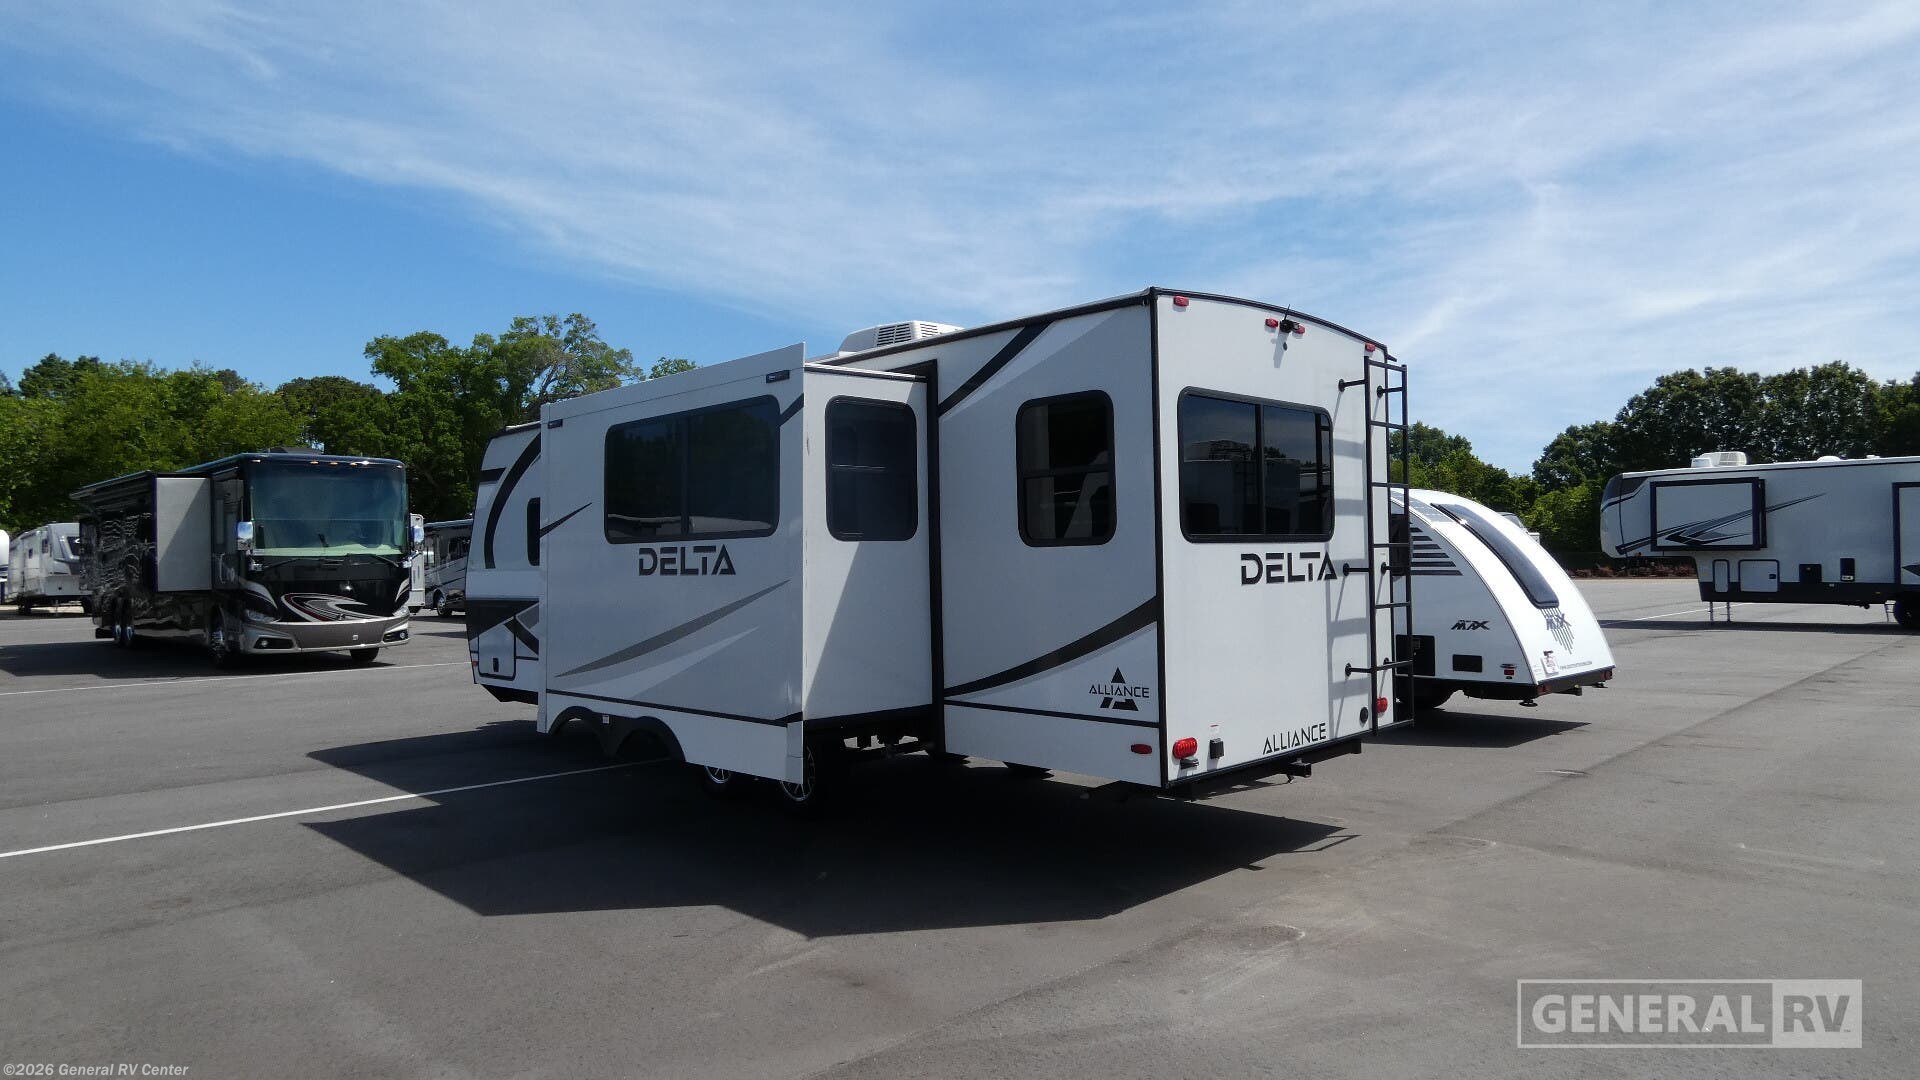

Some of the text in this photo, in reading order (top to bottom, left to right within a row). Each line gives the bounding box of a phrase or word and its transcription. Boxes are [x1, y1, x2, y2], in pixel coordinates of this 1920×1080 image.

[638, 544, 737, 576] DELTA
[1240, 551, 1338, 586] DELTA
[1451, 620, 1490, 631] MAX
[1088, 683, 1150, 699] ALLIANCE
[1262, 722, 1327, 755] ALLIANCE
